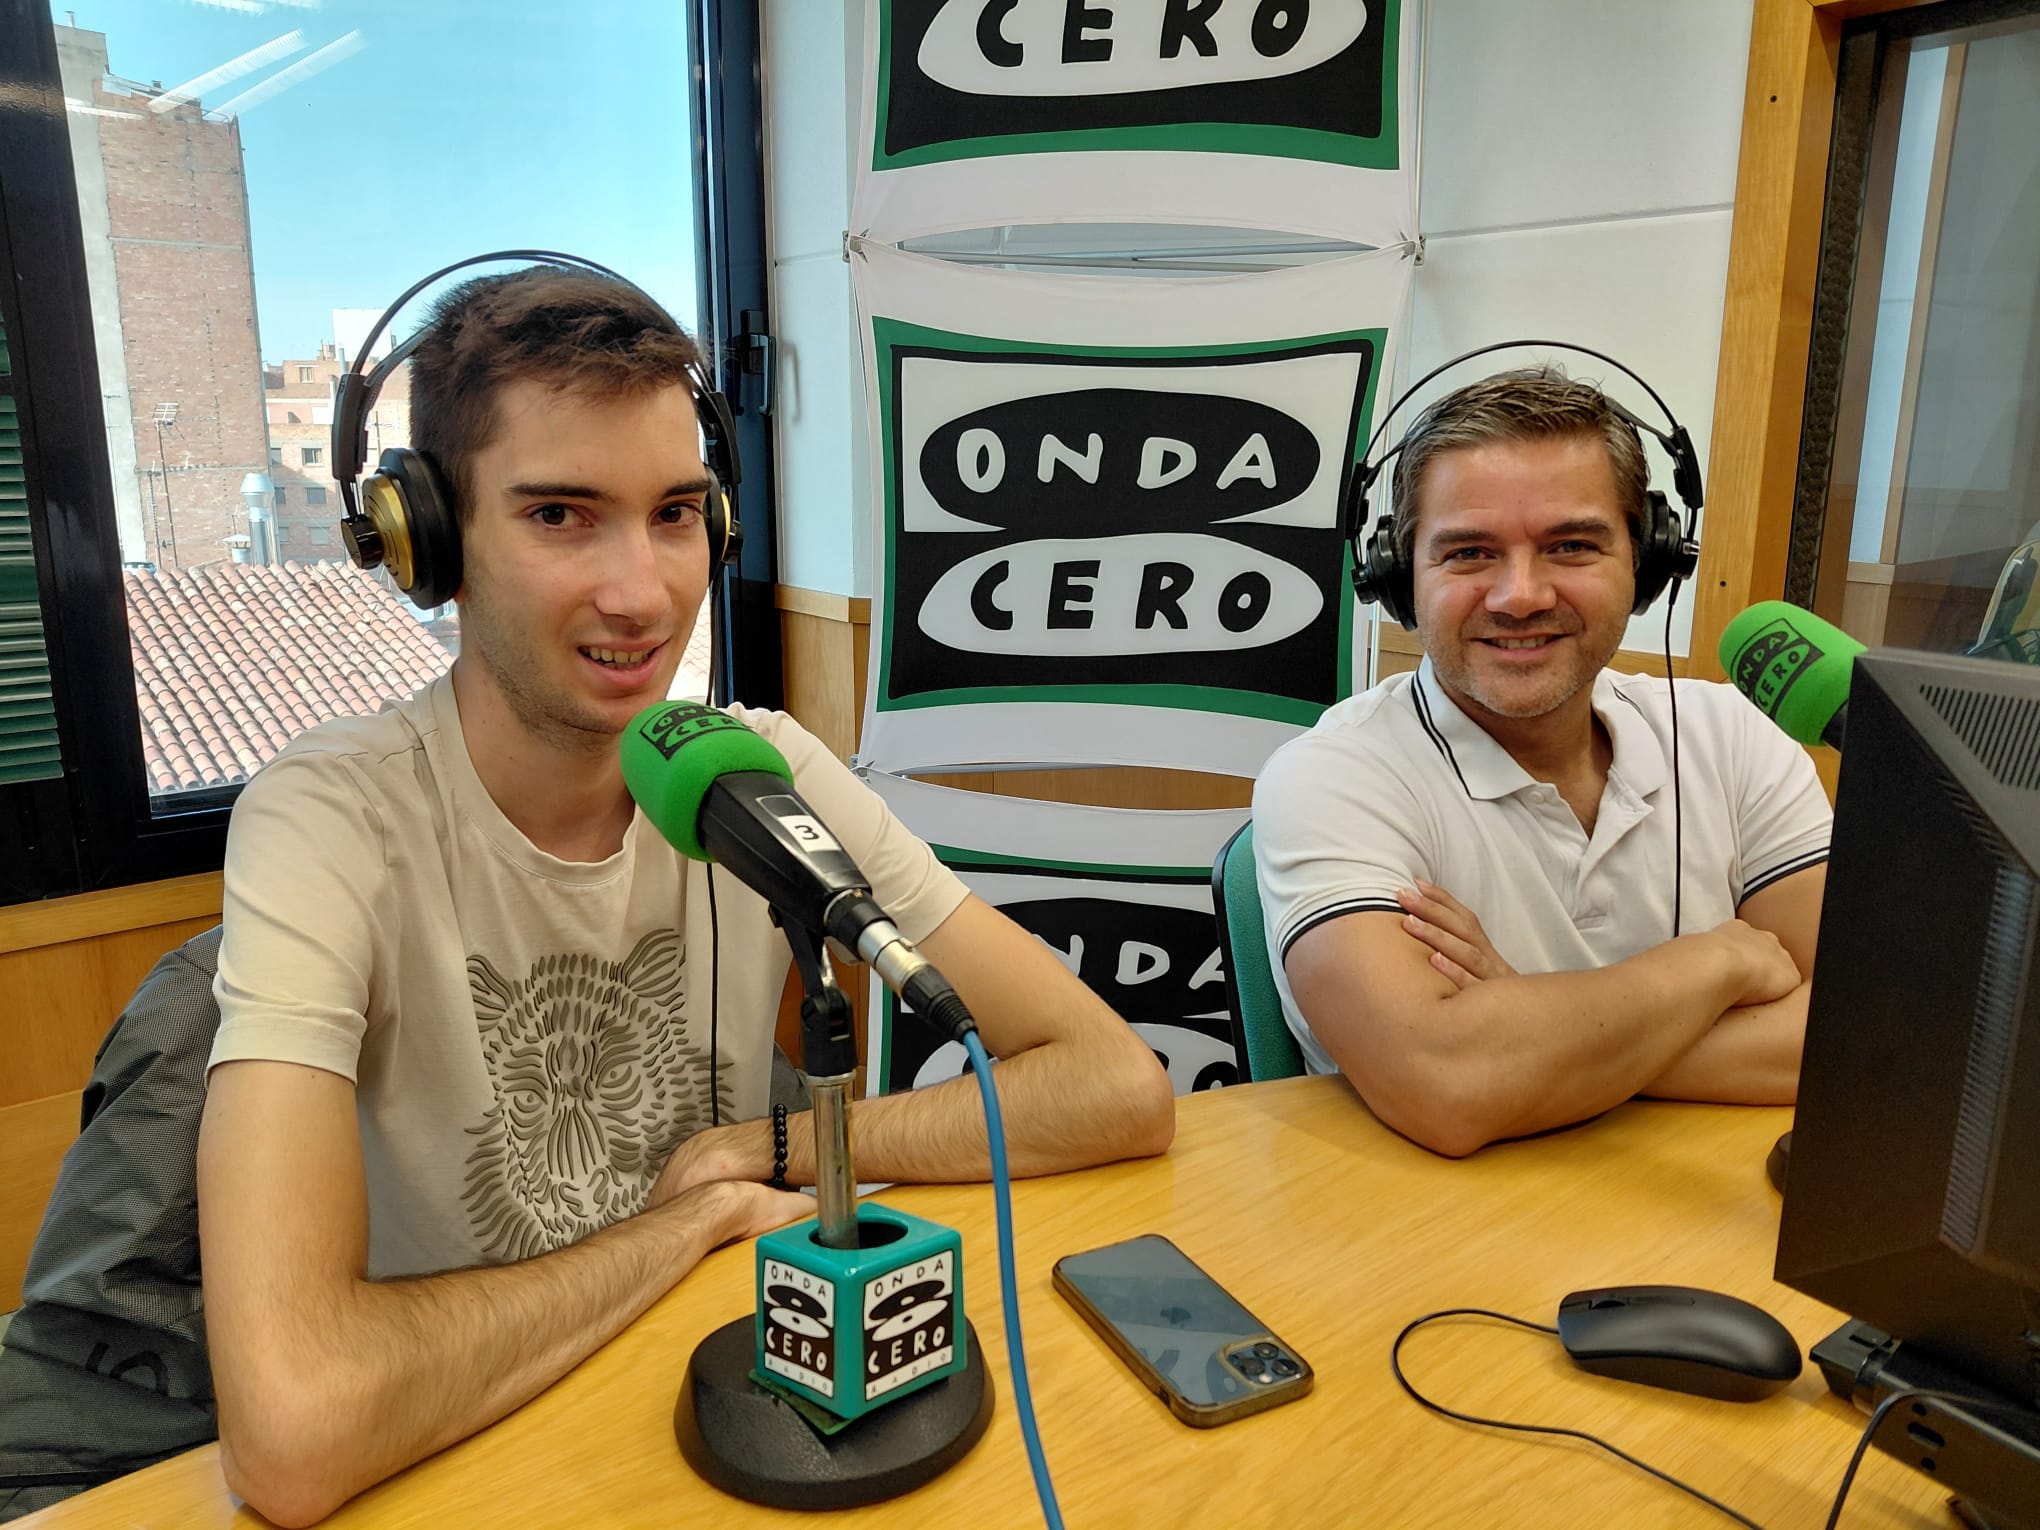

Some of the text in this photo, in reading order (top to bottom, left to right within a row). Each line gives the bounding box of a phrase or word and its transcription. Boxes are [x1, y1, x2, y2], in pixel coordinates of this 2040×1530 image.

[976, 0, 1310, 67] CERO
[956, 427, 1278, 494] ONDA
[970, 559, 1272, 634] CERO
[1756, 650, 1800, 708] CERO
[676, 718, 735, 736] CER
[794, 824, 820, 840] 3
[771, 1264, 827, 1298] ONDA
[874, 1258, 944, 1297] ONDA
[766, 1326, 828, 1372] CERO
[868, 1326, 946, 1374] CERO
